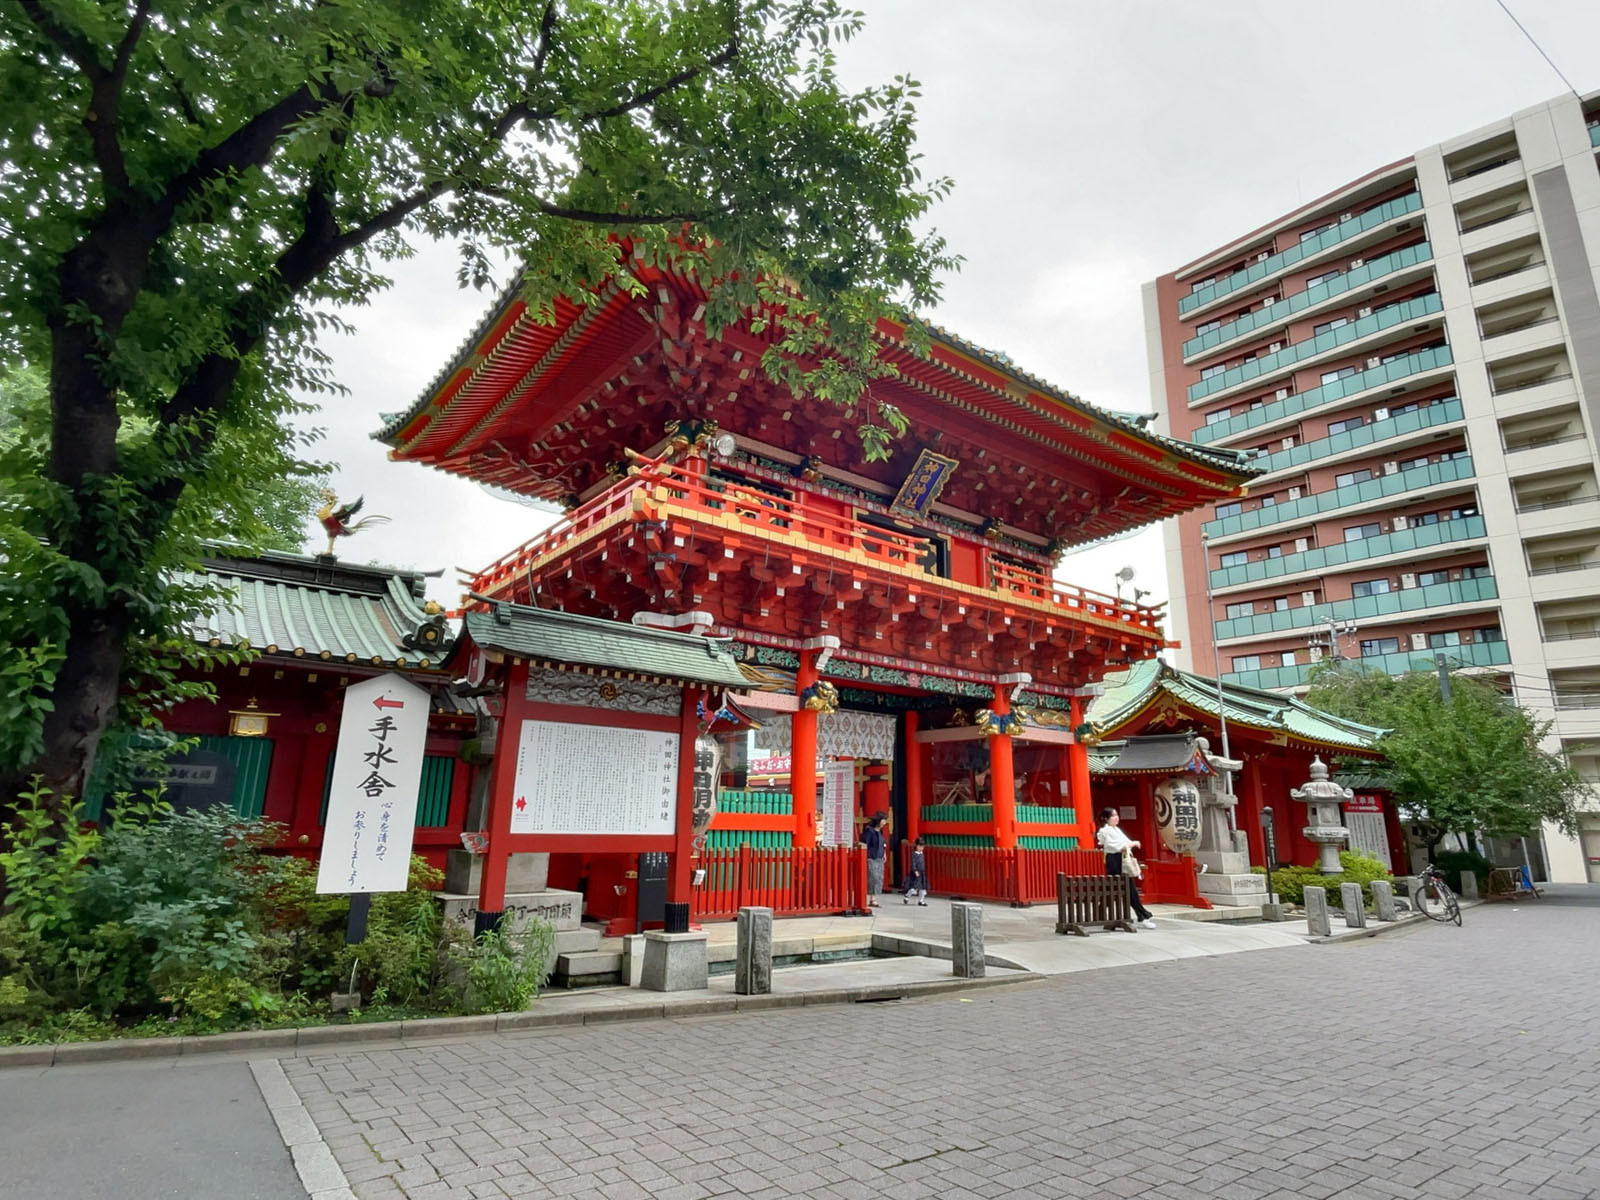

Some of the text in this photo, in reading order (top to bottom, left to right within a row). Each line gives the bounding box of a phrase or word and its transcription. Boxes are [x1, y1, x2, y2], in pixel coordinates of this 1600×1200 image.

[357, 715, 398, 798] 手水舎
[375, 801, 393, 861] 心身を清めて
[1172, 790, 1199, 841] 神田明神
